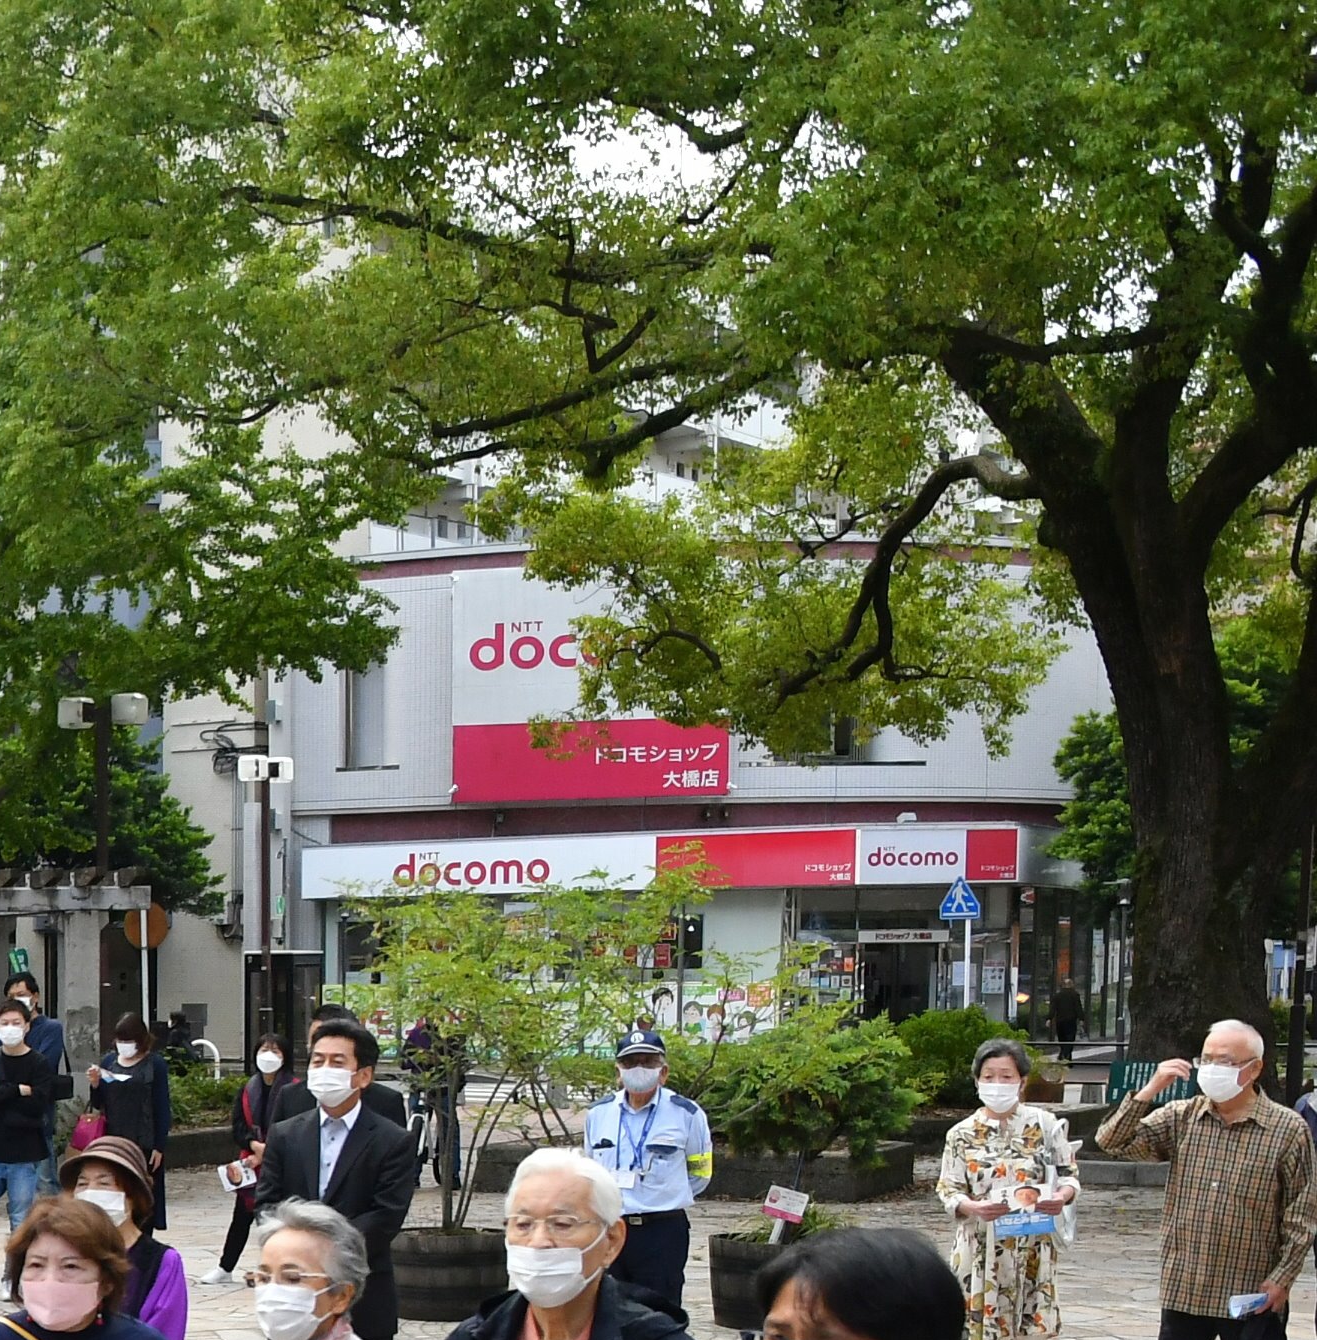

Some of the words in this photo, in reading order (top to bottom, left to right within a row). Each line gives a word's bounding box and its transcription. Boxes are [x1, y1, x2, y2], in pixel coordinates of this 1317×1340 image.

[511, 621, 543, 632] NTT
[595, 743, 720, 765] ドコモショップ
[662, 769, 720, 788] 大橋店
[419, 852, 440, 861] NTT
[868, 847, 959, 867] docomo
[392, 853, 550, 888] docomo
[804, 863, 852, 872] ドコモショップ
[829, 873, 851, 881] 大橋店
